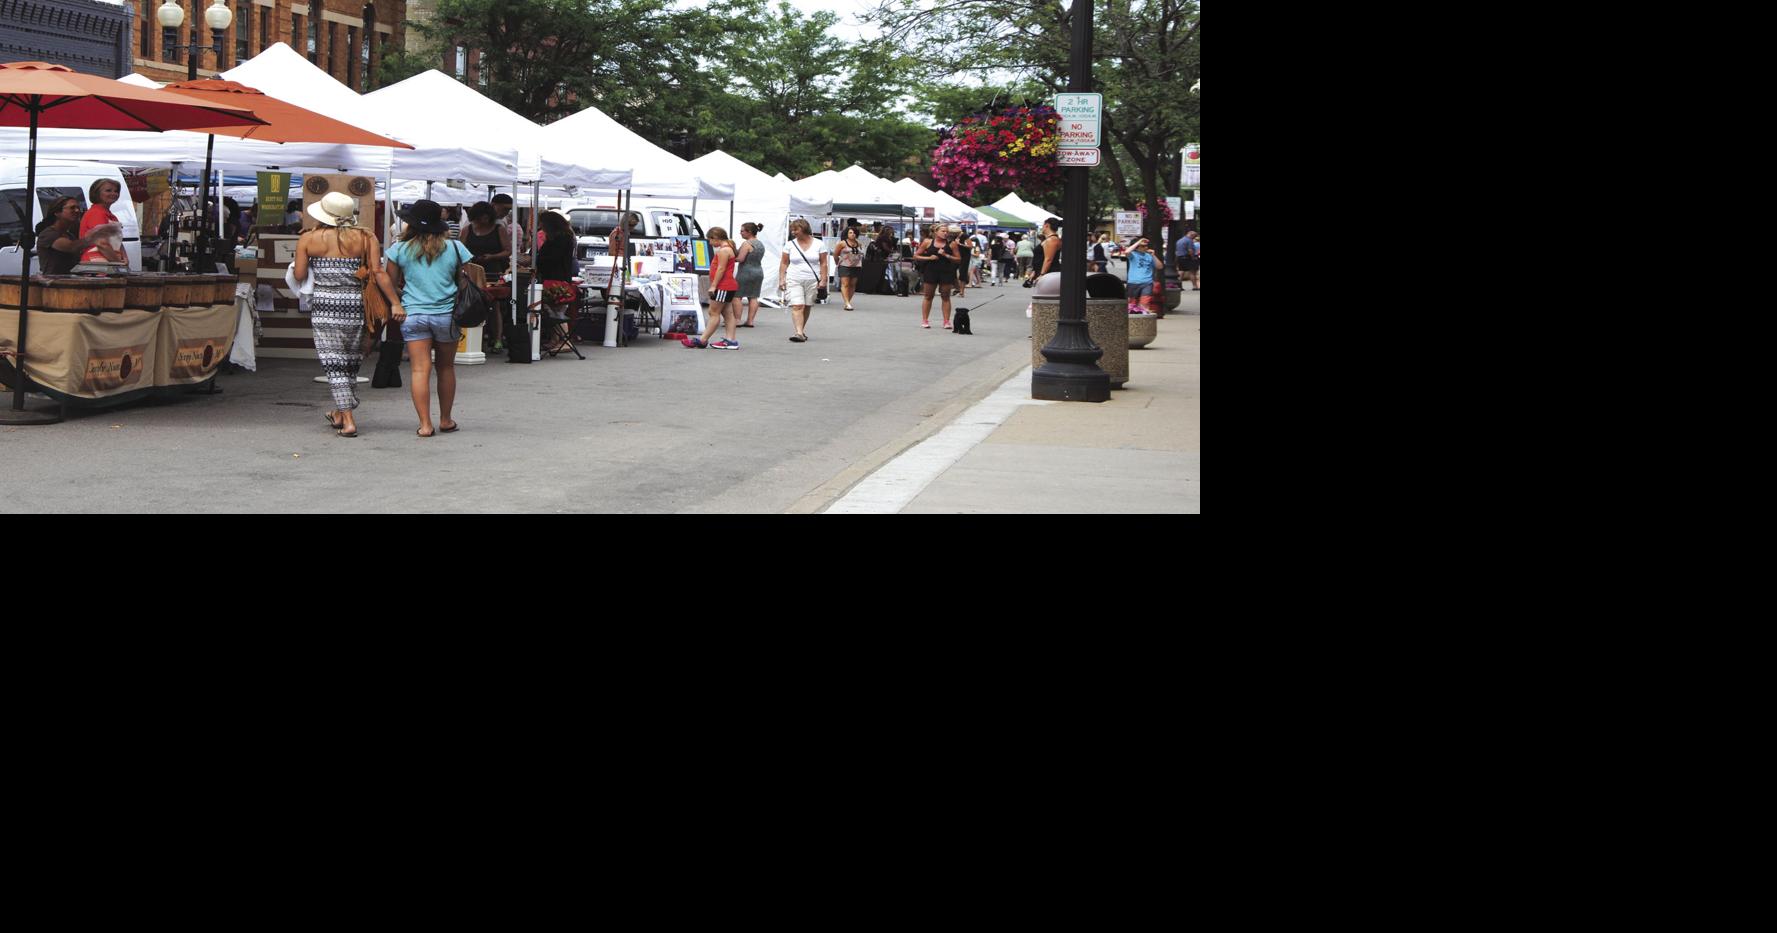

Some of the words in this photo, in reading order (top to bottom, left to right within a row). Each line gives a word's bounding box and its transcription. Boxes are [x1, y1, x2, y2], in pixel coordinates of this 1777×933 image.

[1077, 98, 1089, 106] HR
[1061, 106, 1095, 114] PARKING
[1060, 131, 1094, 139] PARKING
